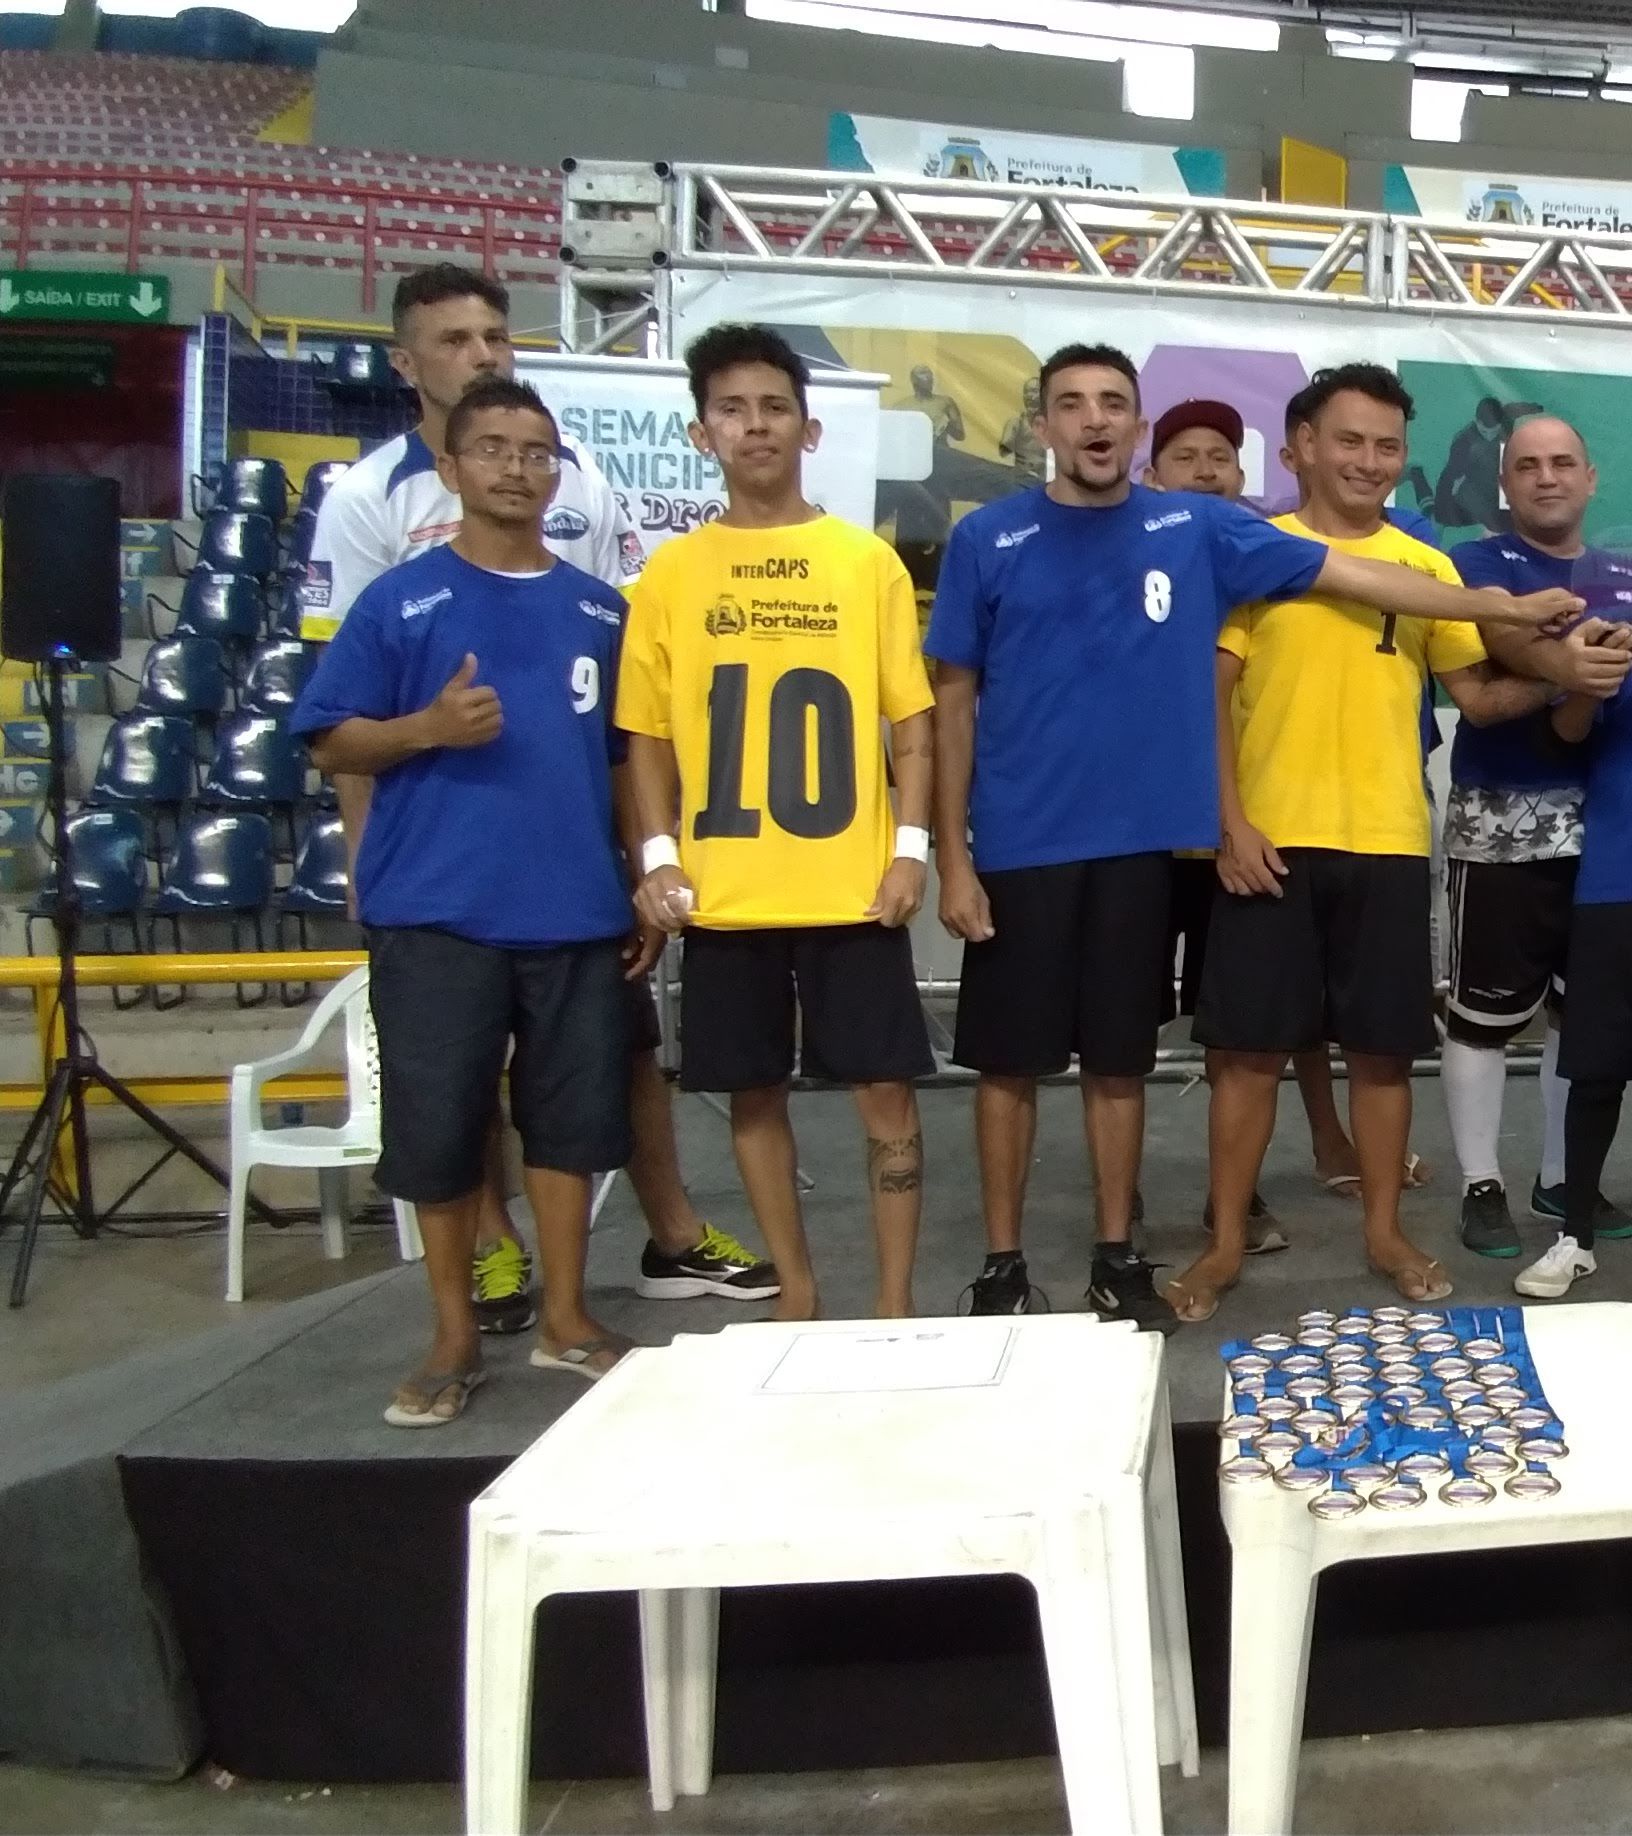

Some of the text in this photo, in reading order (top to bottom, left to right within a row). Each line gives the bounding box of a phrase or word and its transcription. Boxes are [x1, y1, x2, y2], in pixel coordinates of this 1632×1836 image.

[1007, 157, 1093, 176] Prefeitura de
[1542, 201, 1620, 217] Prefeitura de
[86, 291, 121, 308] EXIT
[751, 599, 839, 613] Prefeitura de
[1145, 571, 1172, 623] 8
[751, 612, 838, 631] Fortaleza
[570, 656, 600, 715] 9
[693, 663, 858, 840] 10
